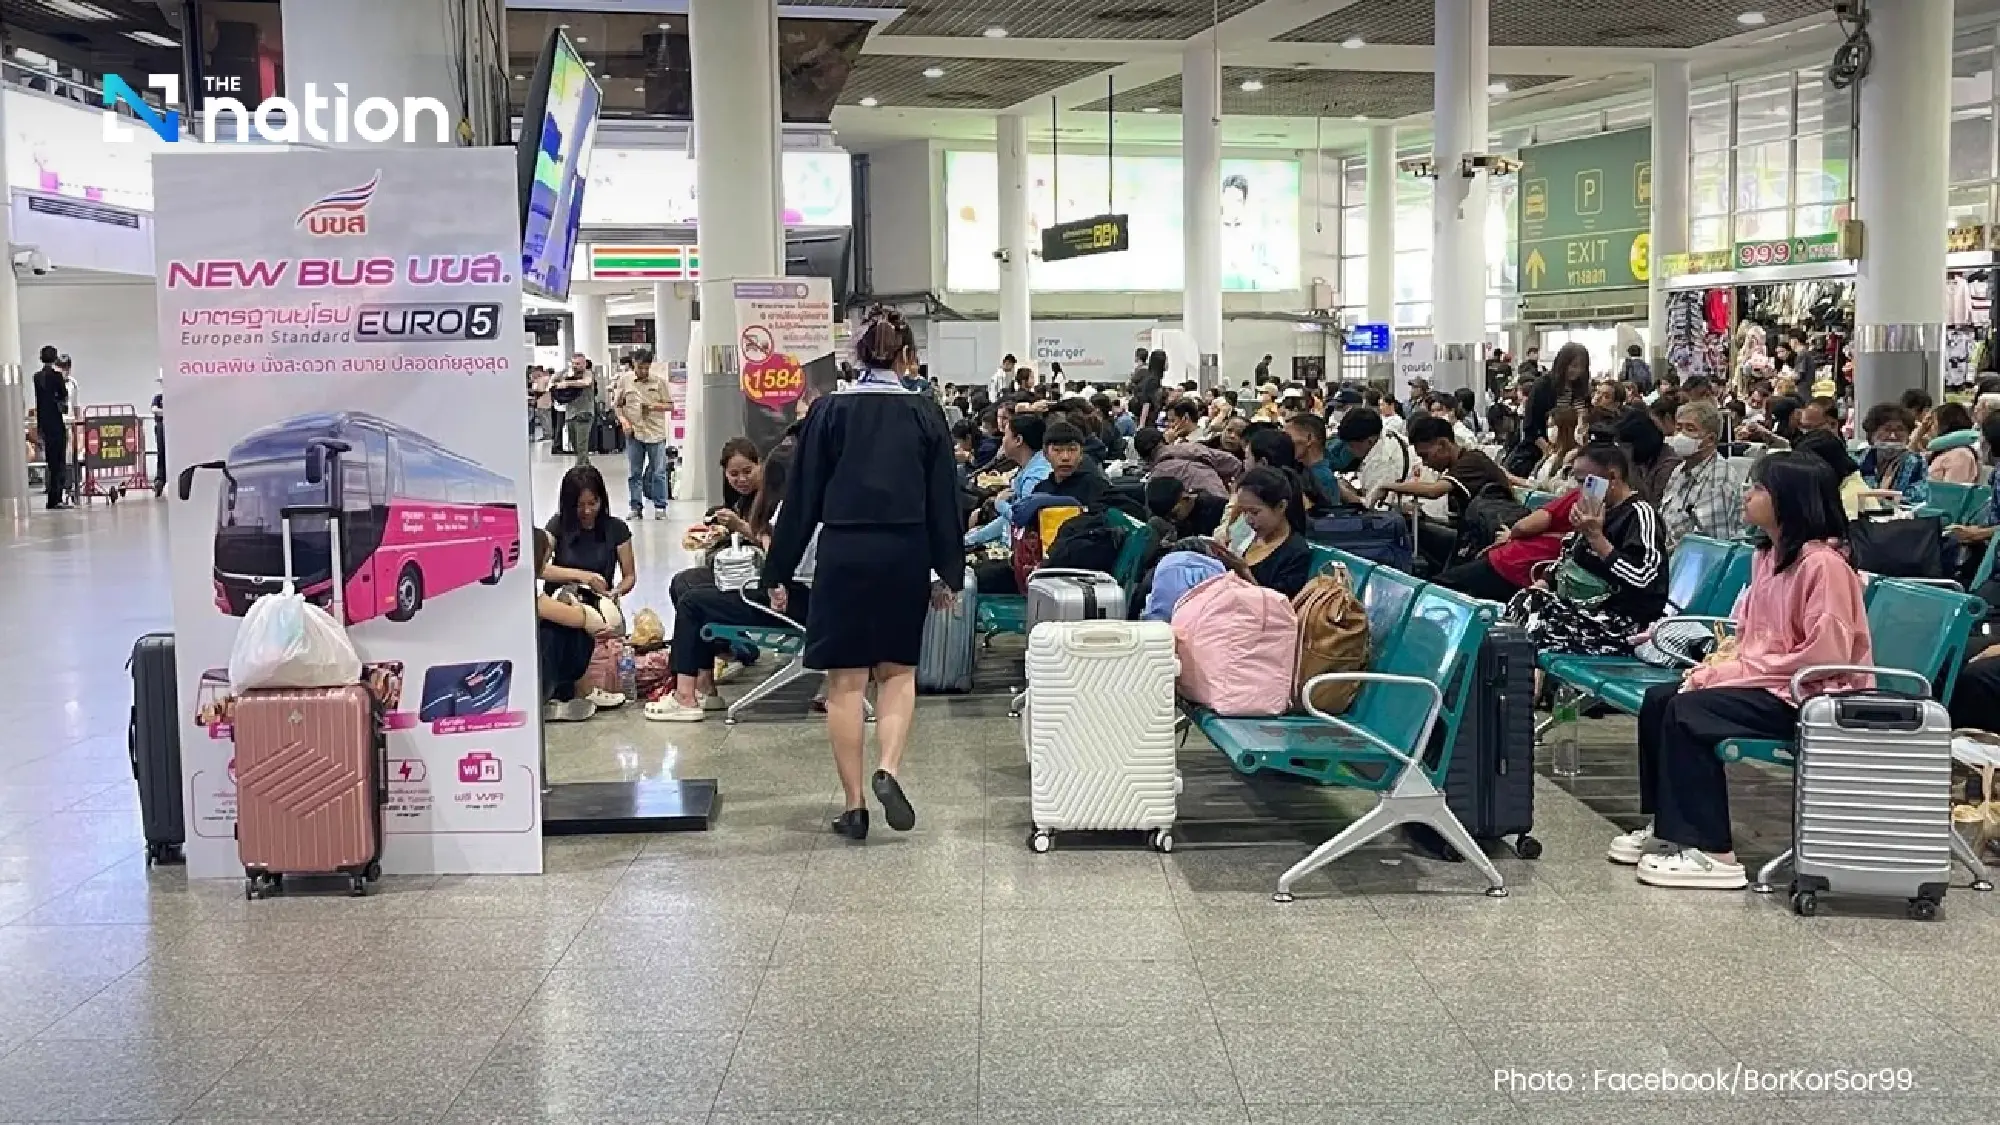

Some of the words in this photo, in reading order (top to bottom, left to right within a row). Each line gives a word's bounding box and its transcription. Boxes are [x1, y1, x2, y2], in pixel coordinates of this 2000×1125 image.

[309, 214, 366, 234] บขส
[1567, 239, 1610, 264] EXIT
[1740, 241, 1792, 266] 999
[167, 260, 289, 288] NEW
[297, 258, 396, 287] BUS
[407, 254, 512, 285] บขส.
[180, 303, 350, 330] มาตรฐานยุโรป
[357, 310, 464, 336] EURO
[469, 306, 494, 338] 5
[180, 331, 264, 347] European
[271, 329, 350, 344] Standard
[342, 357, 387, 373] สบาย
[1037, 347, 1086, 360] Charger
[751, 368, 802, 389] 1584
